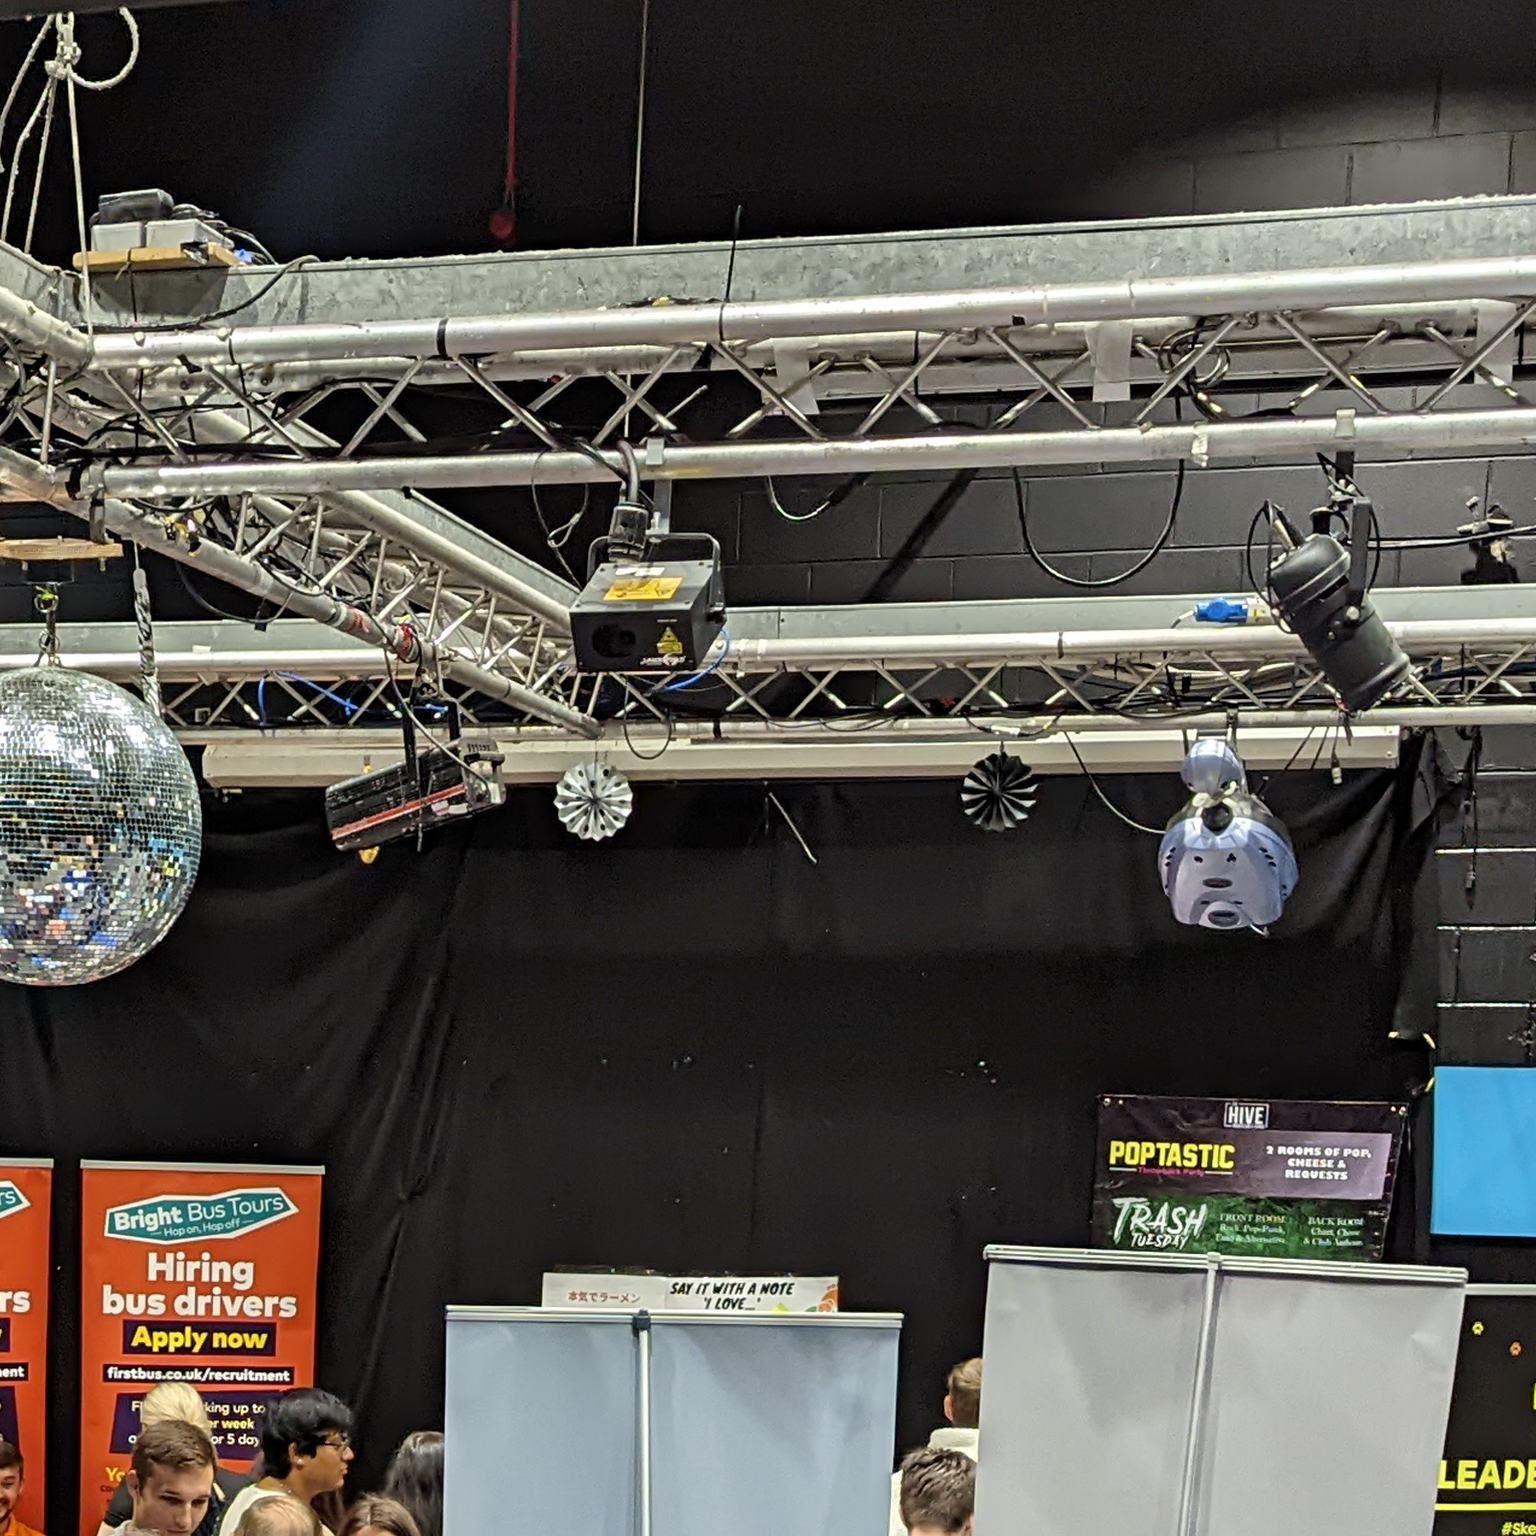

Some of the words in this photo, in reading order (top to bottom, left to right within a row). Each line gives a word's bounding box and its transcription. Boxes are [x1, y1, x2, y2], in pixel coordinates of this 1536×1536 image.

[1228, 1107, 1263, 1125] HIVE
[1110, 1140, 1235, 1169] POPTASTIC
[1278, 1146, 1322, 1157] ROOMS
[1325, 1148, 1341, 1157] OF
[1288, 1158, 1334, 1168] CHEESE
[1337, 1159, 1346, 1168] &
[1285, 1169, 1347, 1180] REQUESTS
[114, 1207, 182, 1232] Bright
[187, 1203, 225, 1222] Bus
[227, 1197, 283, 1216] Tours
[1112, 1198, 1207, 1244] TRASH
[164, 1227, 185, 1238] Hop
[203, 1222, 224, 1233] Hop
[225, 1219, 240, 1228] off
[1131, 1234, 1189, 1250] TUESDAY
[148, 1252, 254, 1290] Hiring
[670, 1283, 694, 1295] SAY
[696, 1283, 709, 1295] IT
[713, 1283, 746, 1295] WITH
[748, 1283, 756, 1295] A
[760, 1283, 795, 1295] NOTE
[102, 1285, 166, 1315] bus
[174, 1286, 297, 1318] drivers
[131, 1326, 208, 1352] Apply
[213, 1332, 267, 1348] now
[107, 1366, 290, 1382] firstbus.co.uk/recruitment
